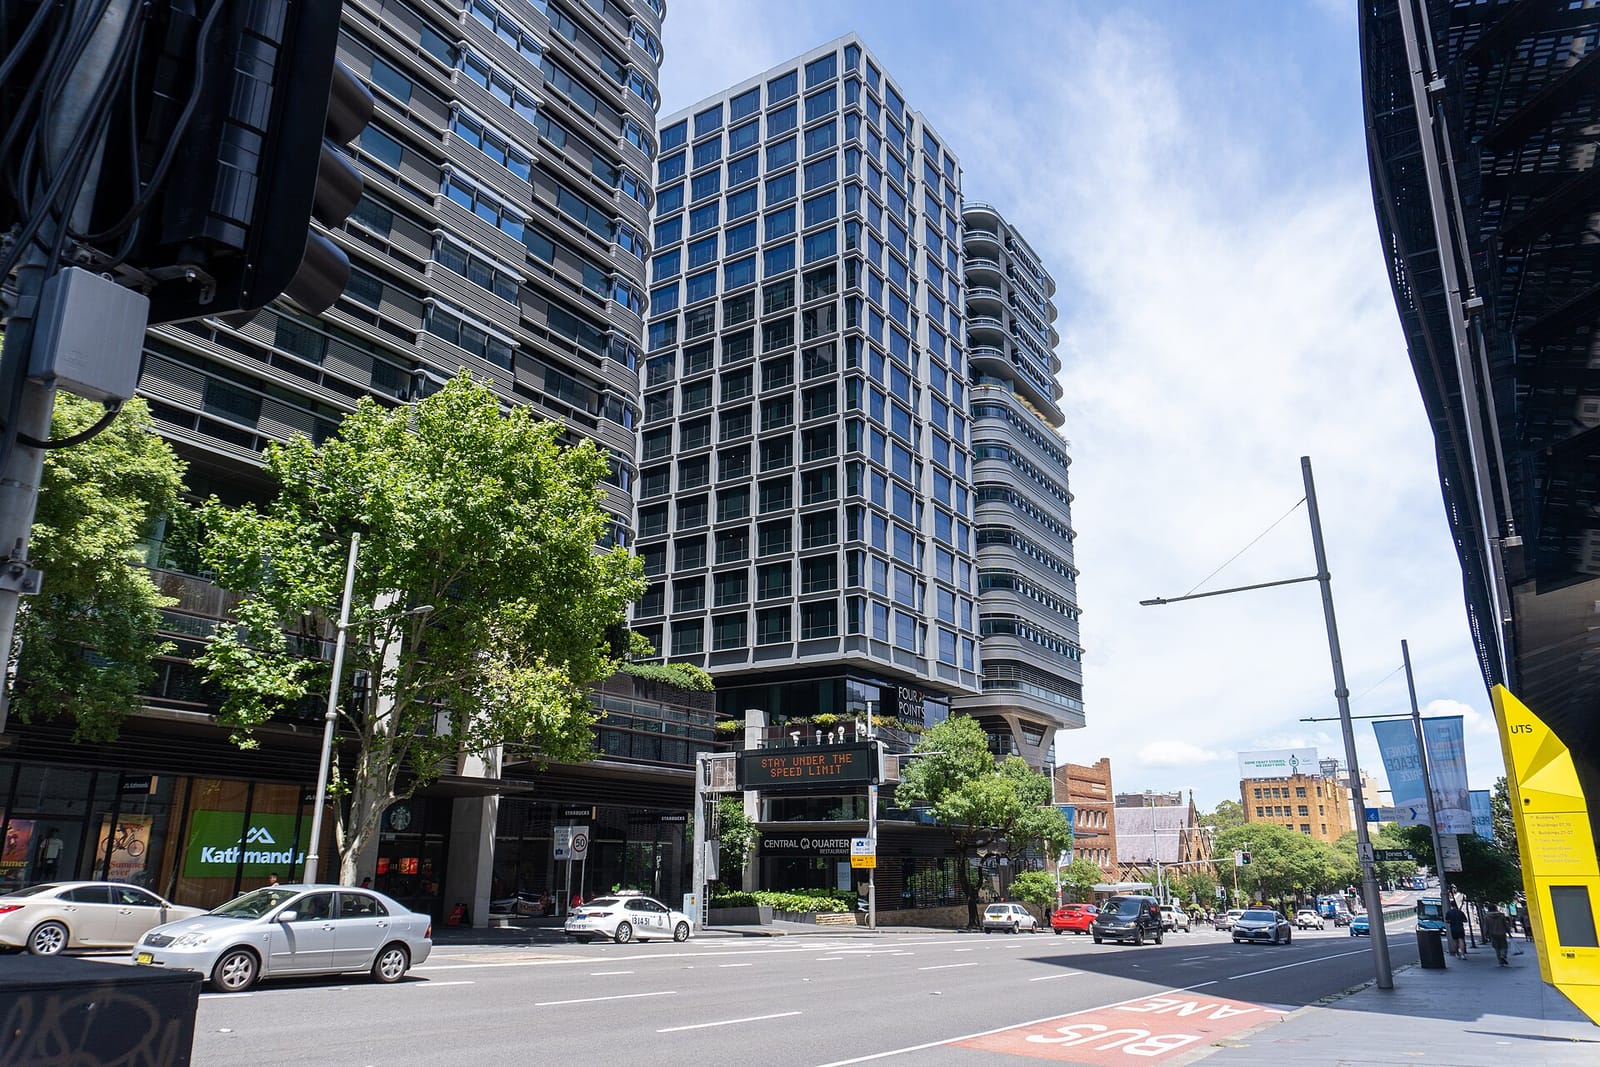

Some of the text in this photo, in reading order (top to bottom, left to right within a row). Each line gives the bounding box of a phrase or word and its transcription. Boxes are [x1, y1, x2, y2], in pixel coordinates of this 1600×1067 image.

[898, 686, 918, 703] FOUR
[898, 701, 925, 719] POINTS
[1510, 724, 1533, 734] UTS
[761, 753, 853, 768] STAY UNDER THE
[770, 764, 842, 778] SPEED LIMIT
[575, 838, 585, 848] 50
[764, 839, 799, 848] CENTRAL
[811, 839, 849, 849] QUARTER
[1025, 1023, 1204, 1057] BUS
